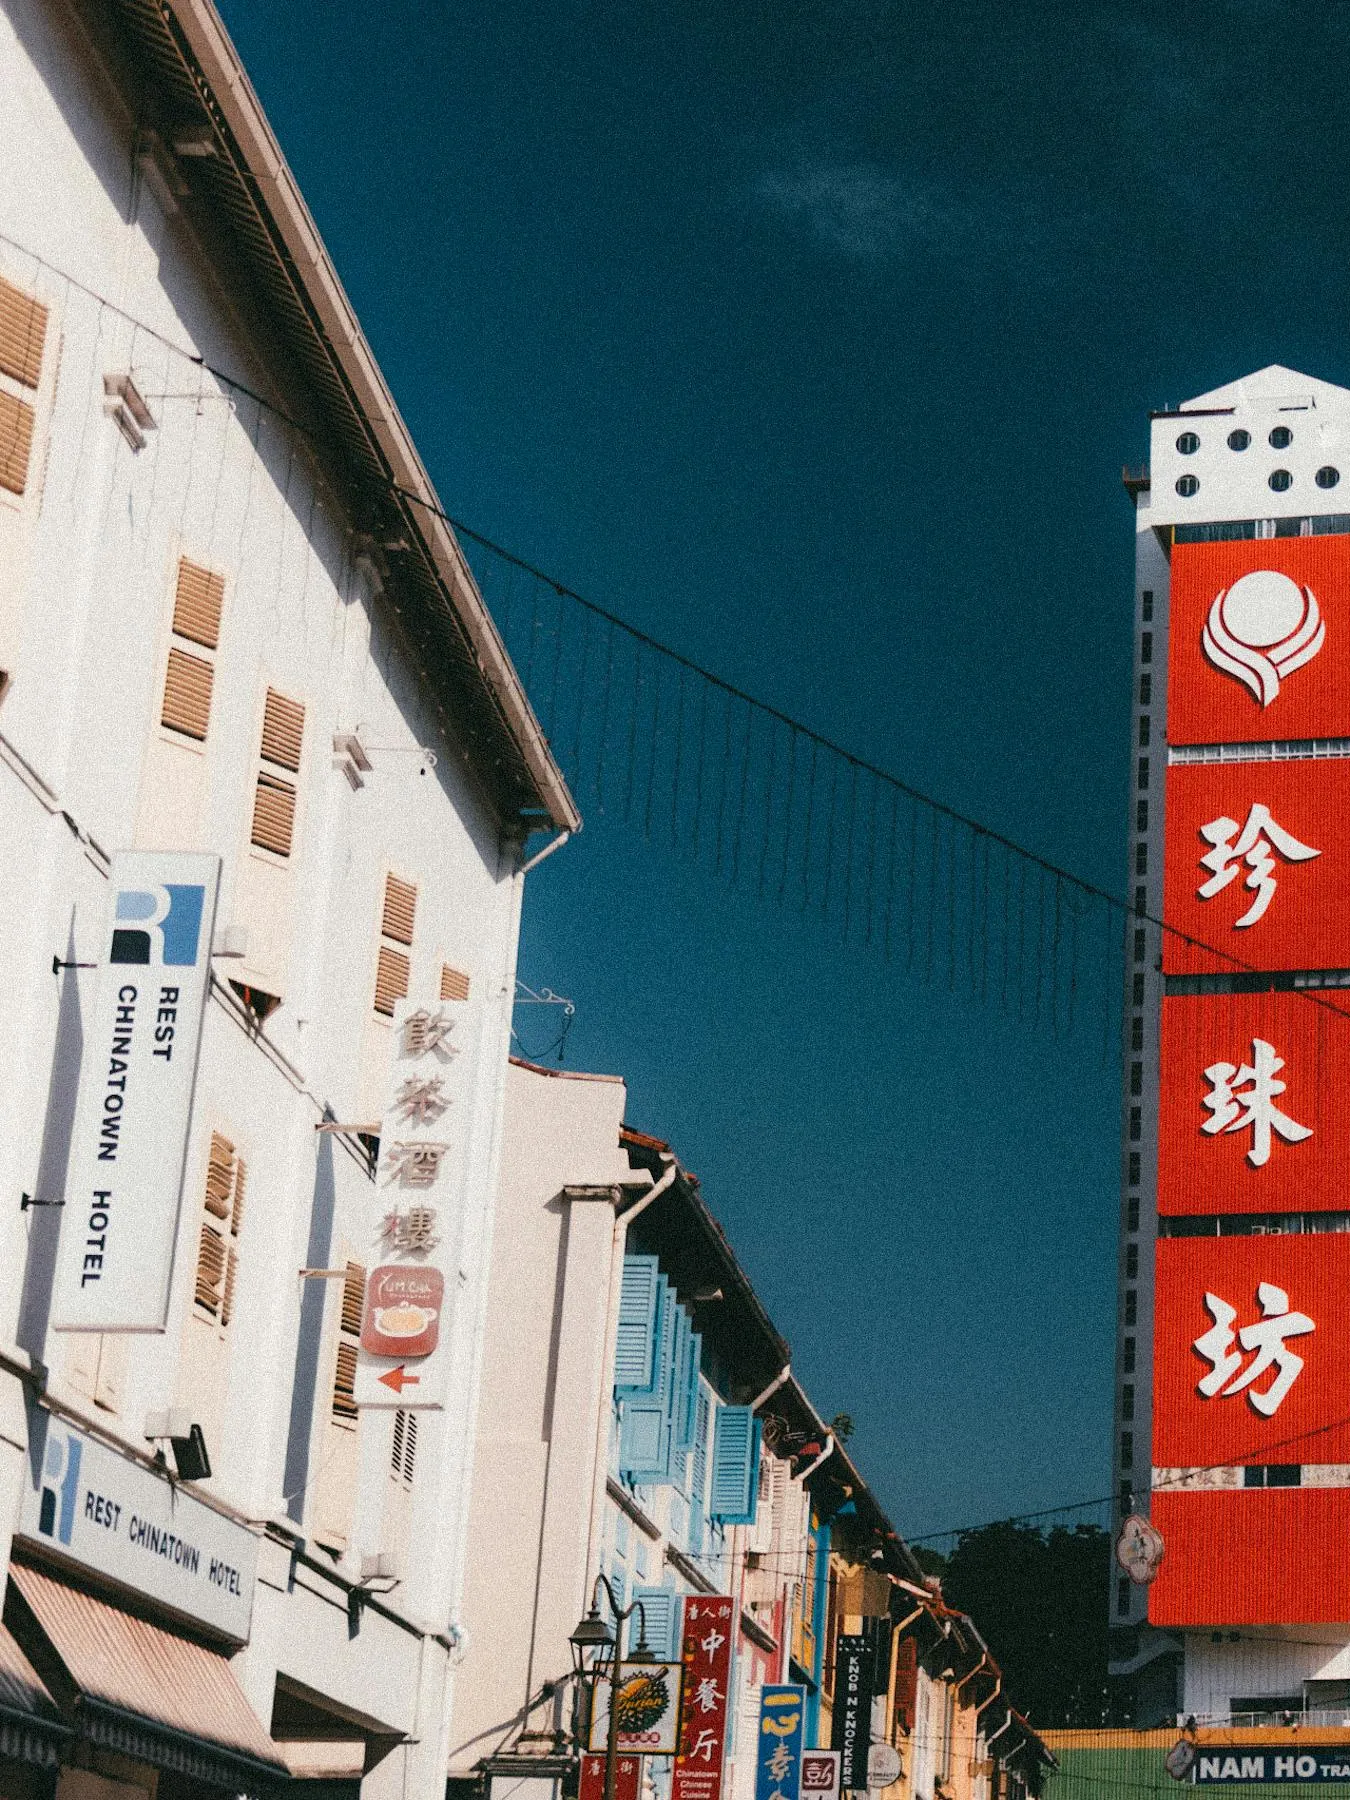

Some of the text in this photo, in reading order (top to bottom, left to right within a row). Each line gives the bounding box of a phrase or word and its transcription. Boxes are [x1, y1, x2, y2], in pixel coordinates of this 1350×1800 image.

[152, 985, 179, 1062] REST
[80, 984, 138, 1289] CHINATOWN HOTEL
[382, 1005, 460, 1258] 飲茶酒樓
[1193, 803, 1321, 1416] 珍珠坊
[84, 1490, 242, 1597] REST CHINATOWN HOTEL
[688, 1604, 732, 1621] 唐人街
[690, 1628, 726, 1763] 中餐厅
[842, 1656, 860, 1785] KNOB N KNOCKERS
[587, 1759, 634, 1776] 唐街
[675, 1769, 719, 1778] Chinatown
[679, 1780, 712, 1788] Chinese
[1199, 1756, 1265, 1779] NAM
[1273, 1755, 1317, 1778] HO
